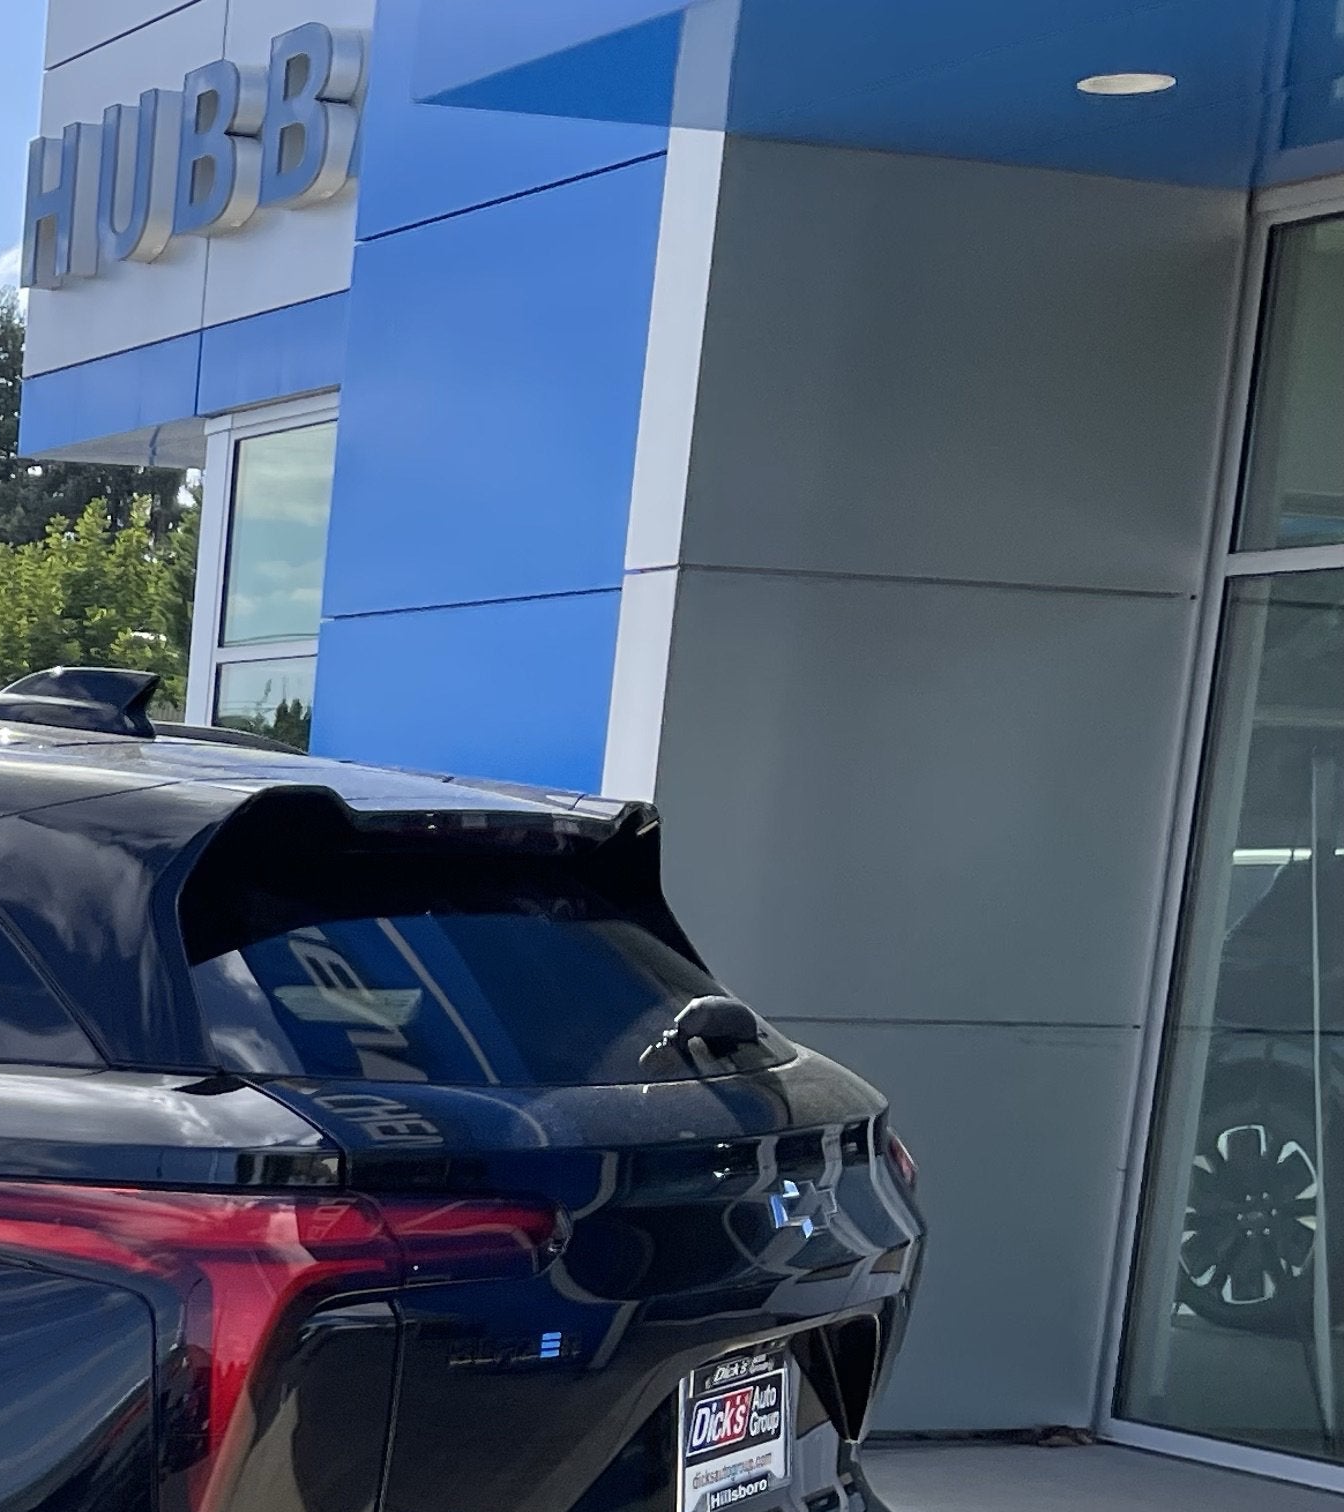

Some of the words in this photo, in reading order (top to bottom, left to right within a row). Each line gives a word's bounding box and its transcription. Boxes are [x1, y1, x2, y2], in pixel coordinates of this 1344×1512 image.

[21, 22, 358, 290] HUBB
[753, 1384, 777, 1410] Auto
[692, 1396, 746, 1447] Dick's
[749, 1411, 779, 1437] Group
[710, 1479, 768, 1509] Hillsboro
